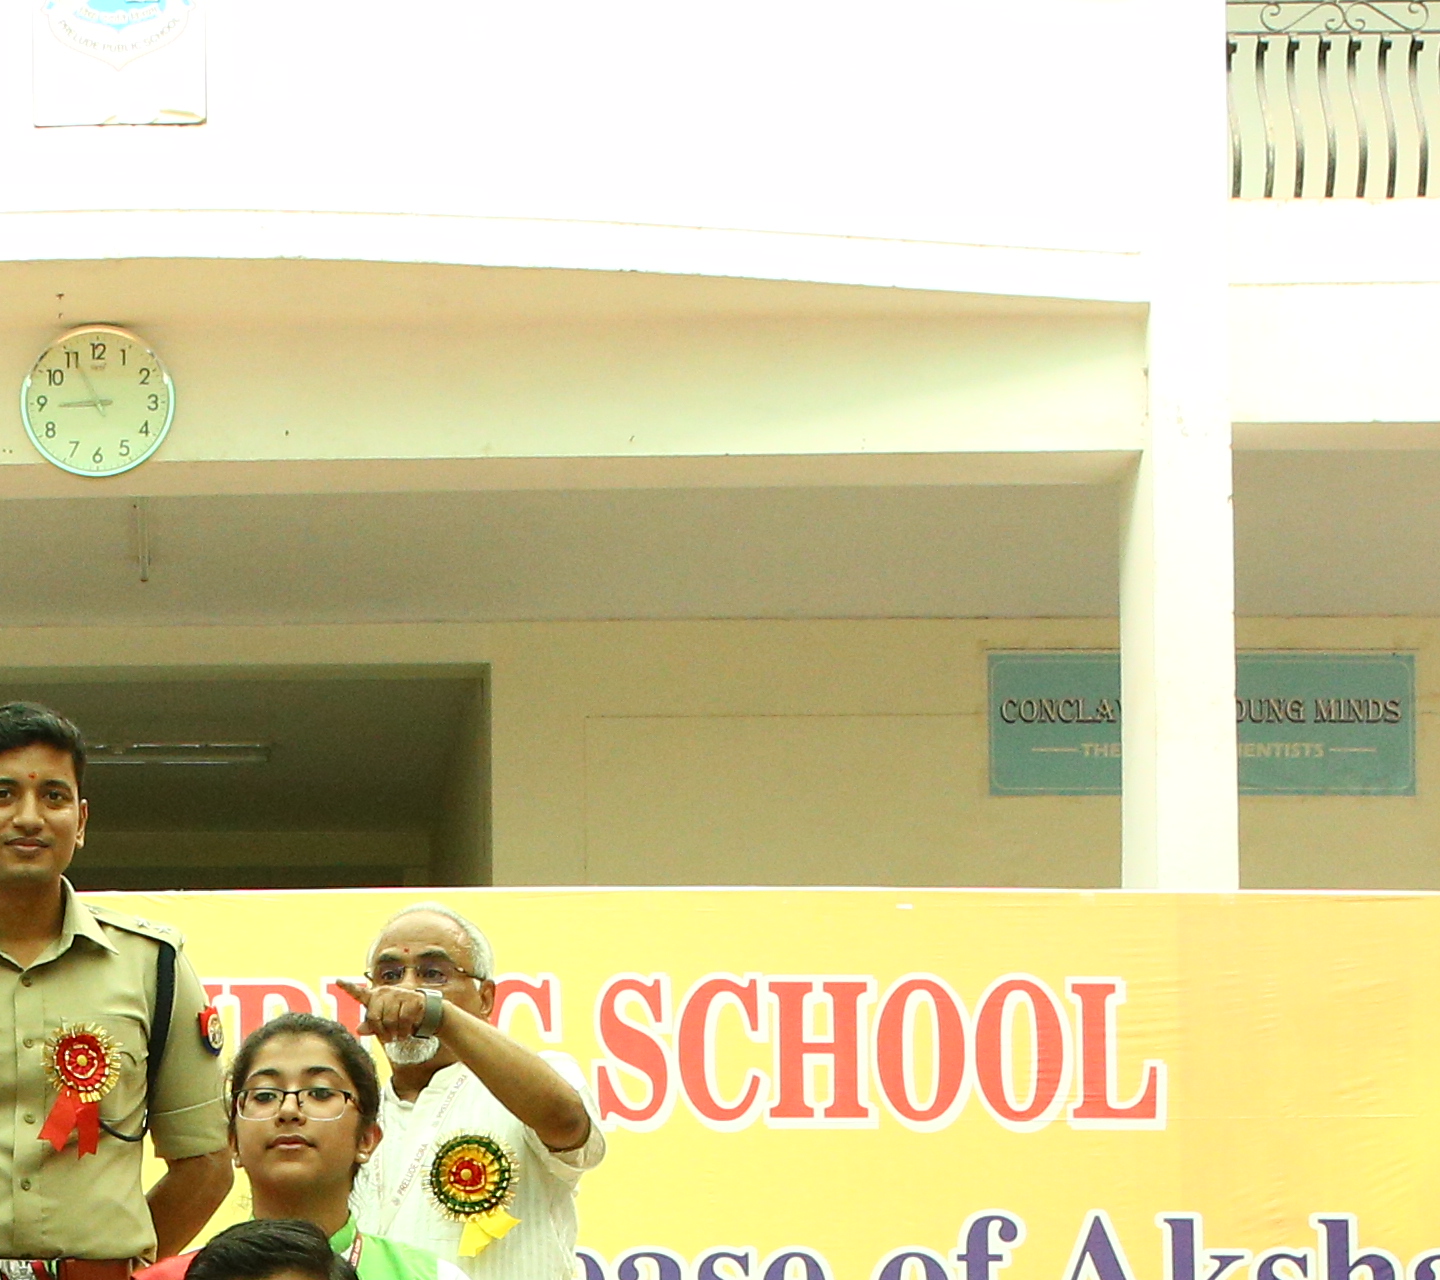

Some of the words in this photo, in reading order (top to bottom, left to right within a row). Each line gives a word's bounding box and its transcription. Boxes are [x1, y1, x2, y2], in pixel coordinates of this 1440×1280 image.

[90, 343, 106, 360] 12
[121, 349, 126, 365] 1
[65, 352, 78, 368] 11
[47, 370, 63, 386] 10
[139, 368, 150, 385] 2
[37, 396, 47, 412] 9
[148, 394, 158, 411] 3
[45, 422, 56, 438] 8
[139, 421, 149, 436] 4
[69, 441, 80, 457] 7
[92, 448, 103, 463] 6
[120, 440, 130, 456] 5
[1000, 698, 1121, 725] CONCLA
[1313, 698, 1402, 725] MINDS
[1080, 742, 1121, 759] THE
[1237, 742, 1325, 759] IENTISTS
[598, 976, 1161, 1121] SCHOOL
